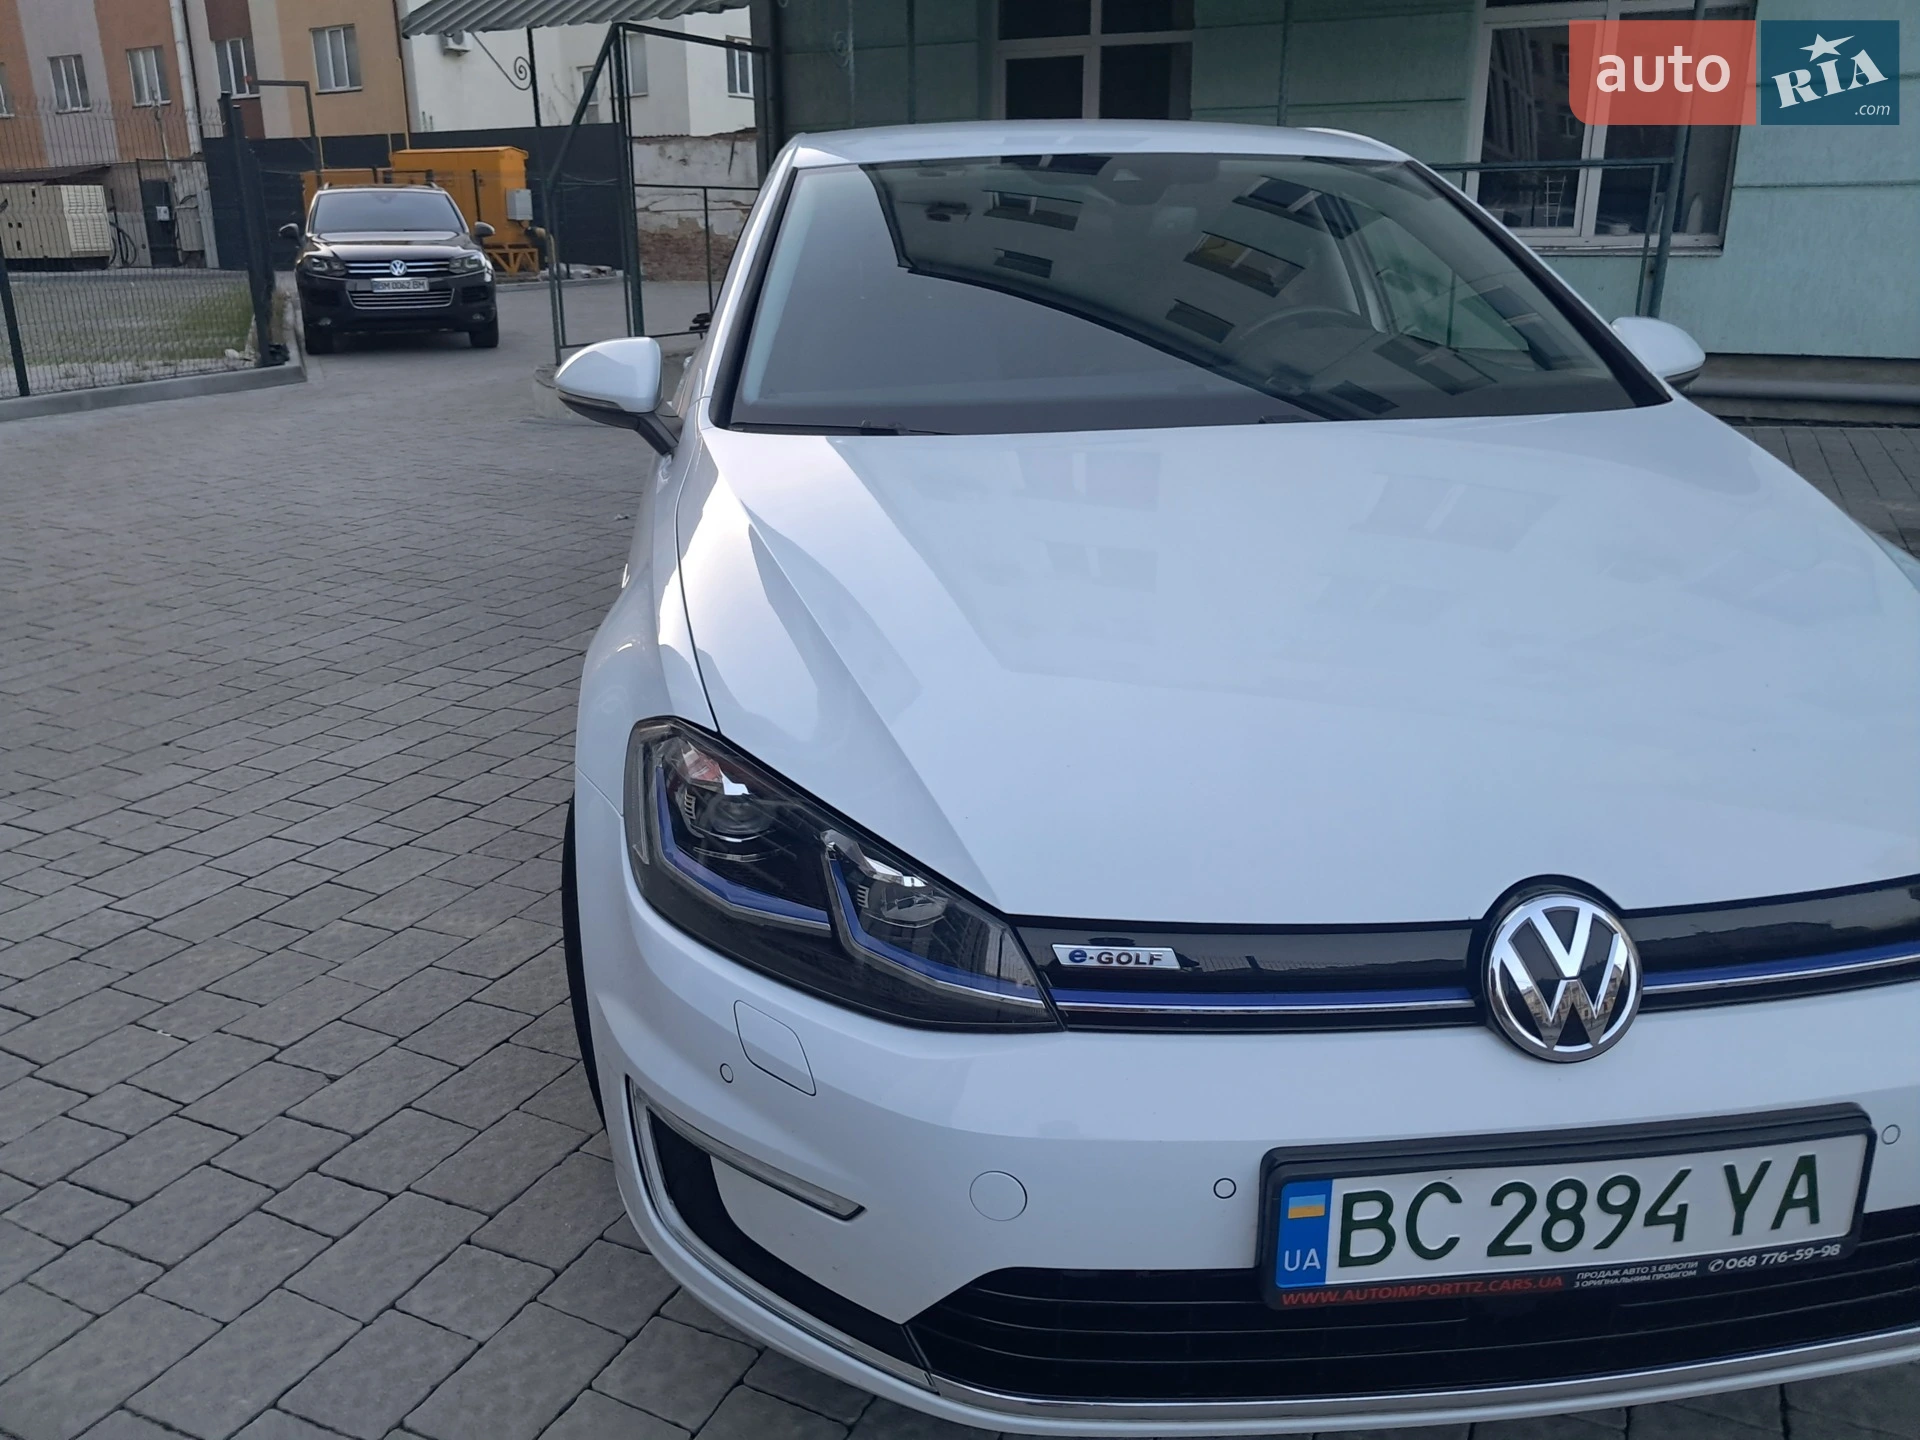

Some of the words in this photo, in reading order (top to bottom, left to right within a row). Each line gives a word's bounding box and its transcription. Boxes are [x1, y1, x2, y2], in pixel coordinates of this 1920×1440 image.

[1068, 948, 1163, 965] e-GOLF
[1337, 1181, 1463, 1269] BC
[1486, 1168, 1692, 1258] 2894
[1723, 1154, 1821, 1236] YA
[1284, 1249, 1322, 1272] UA
[1725, 1254, 1757, 1270] 068
[1760, 1243, 1841, 1265] 776-59-98
[1576, 1268, 1621, 1280] ПРОДАЖ
[1621, 1266, 1649, 1276] АВТО
[1281, 1275, 1564, 1305] WWW.AUTOIMPORTTZ.CARS.UA
